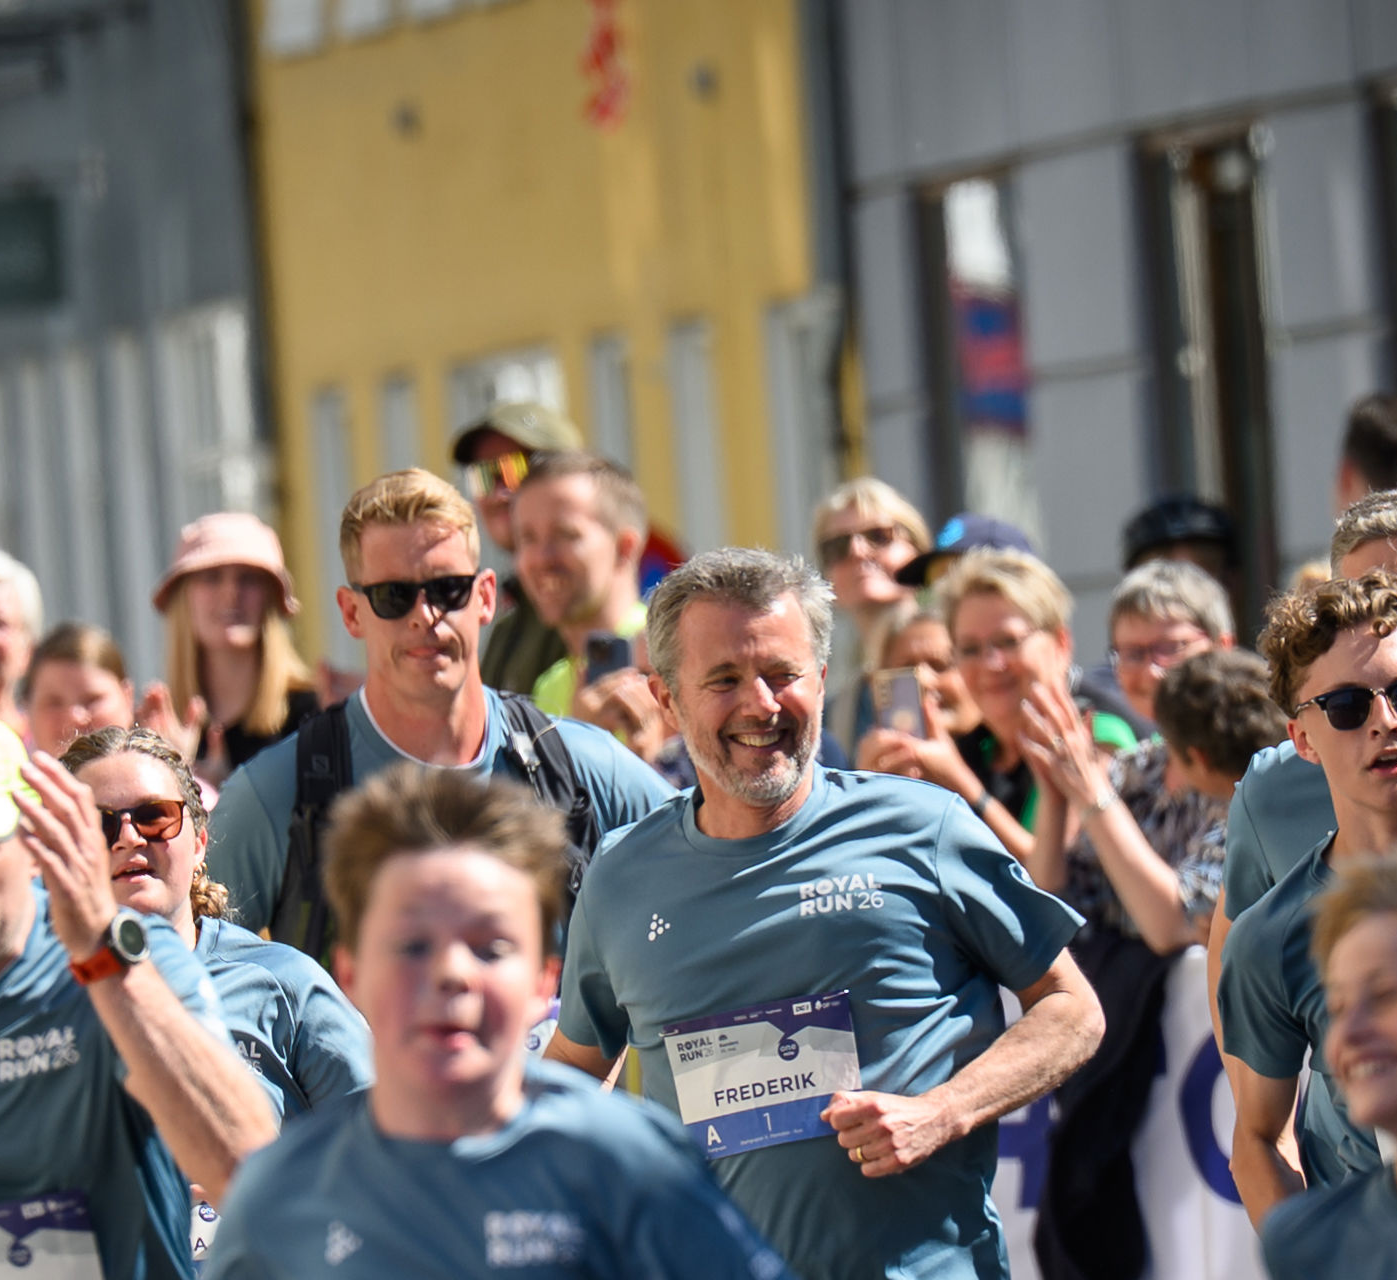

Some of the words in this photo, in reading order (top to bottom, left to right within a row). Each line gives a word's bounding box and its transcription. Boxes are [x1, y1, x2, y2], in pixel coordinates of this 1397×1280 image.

[799, 873, 882, 900] ROYAL
[677, 1037, 712, 1053] ROYAL
[714, 1072, 816, 1107] FREDERIK
[707, 1125, 722, 1146] A
[763, 1112, 772, 1132] 1
